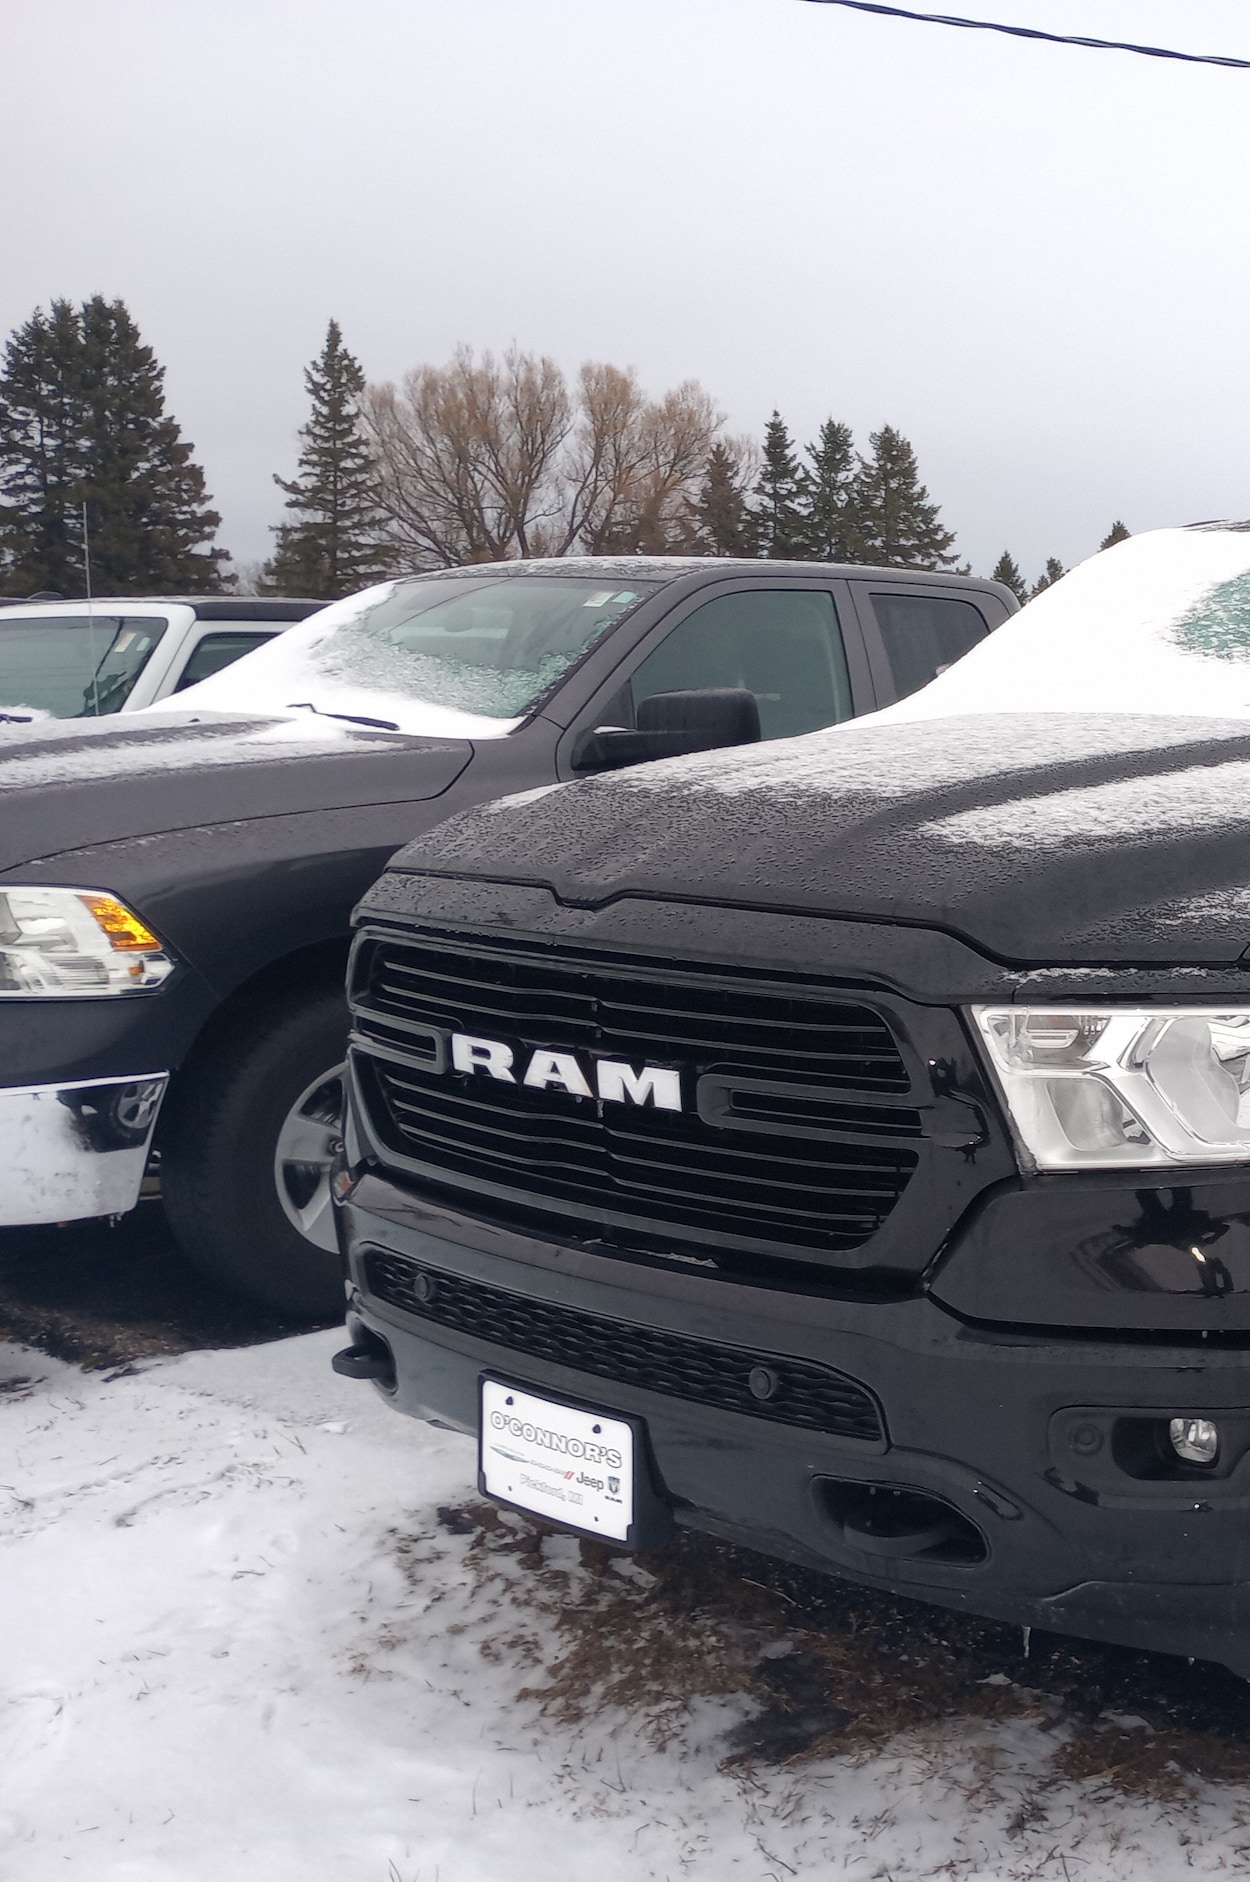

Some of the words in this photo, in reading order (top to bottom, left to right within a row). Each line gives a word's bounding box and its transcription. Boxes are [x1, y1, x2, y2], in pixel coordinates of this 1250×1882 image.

[451, 1033, 682, 1112] RAM
[490, 1410, 622, 1469] O'CONNOR'S
[576, 1472, 604, 1492] Jeep
